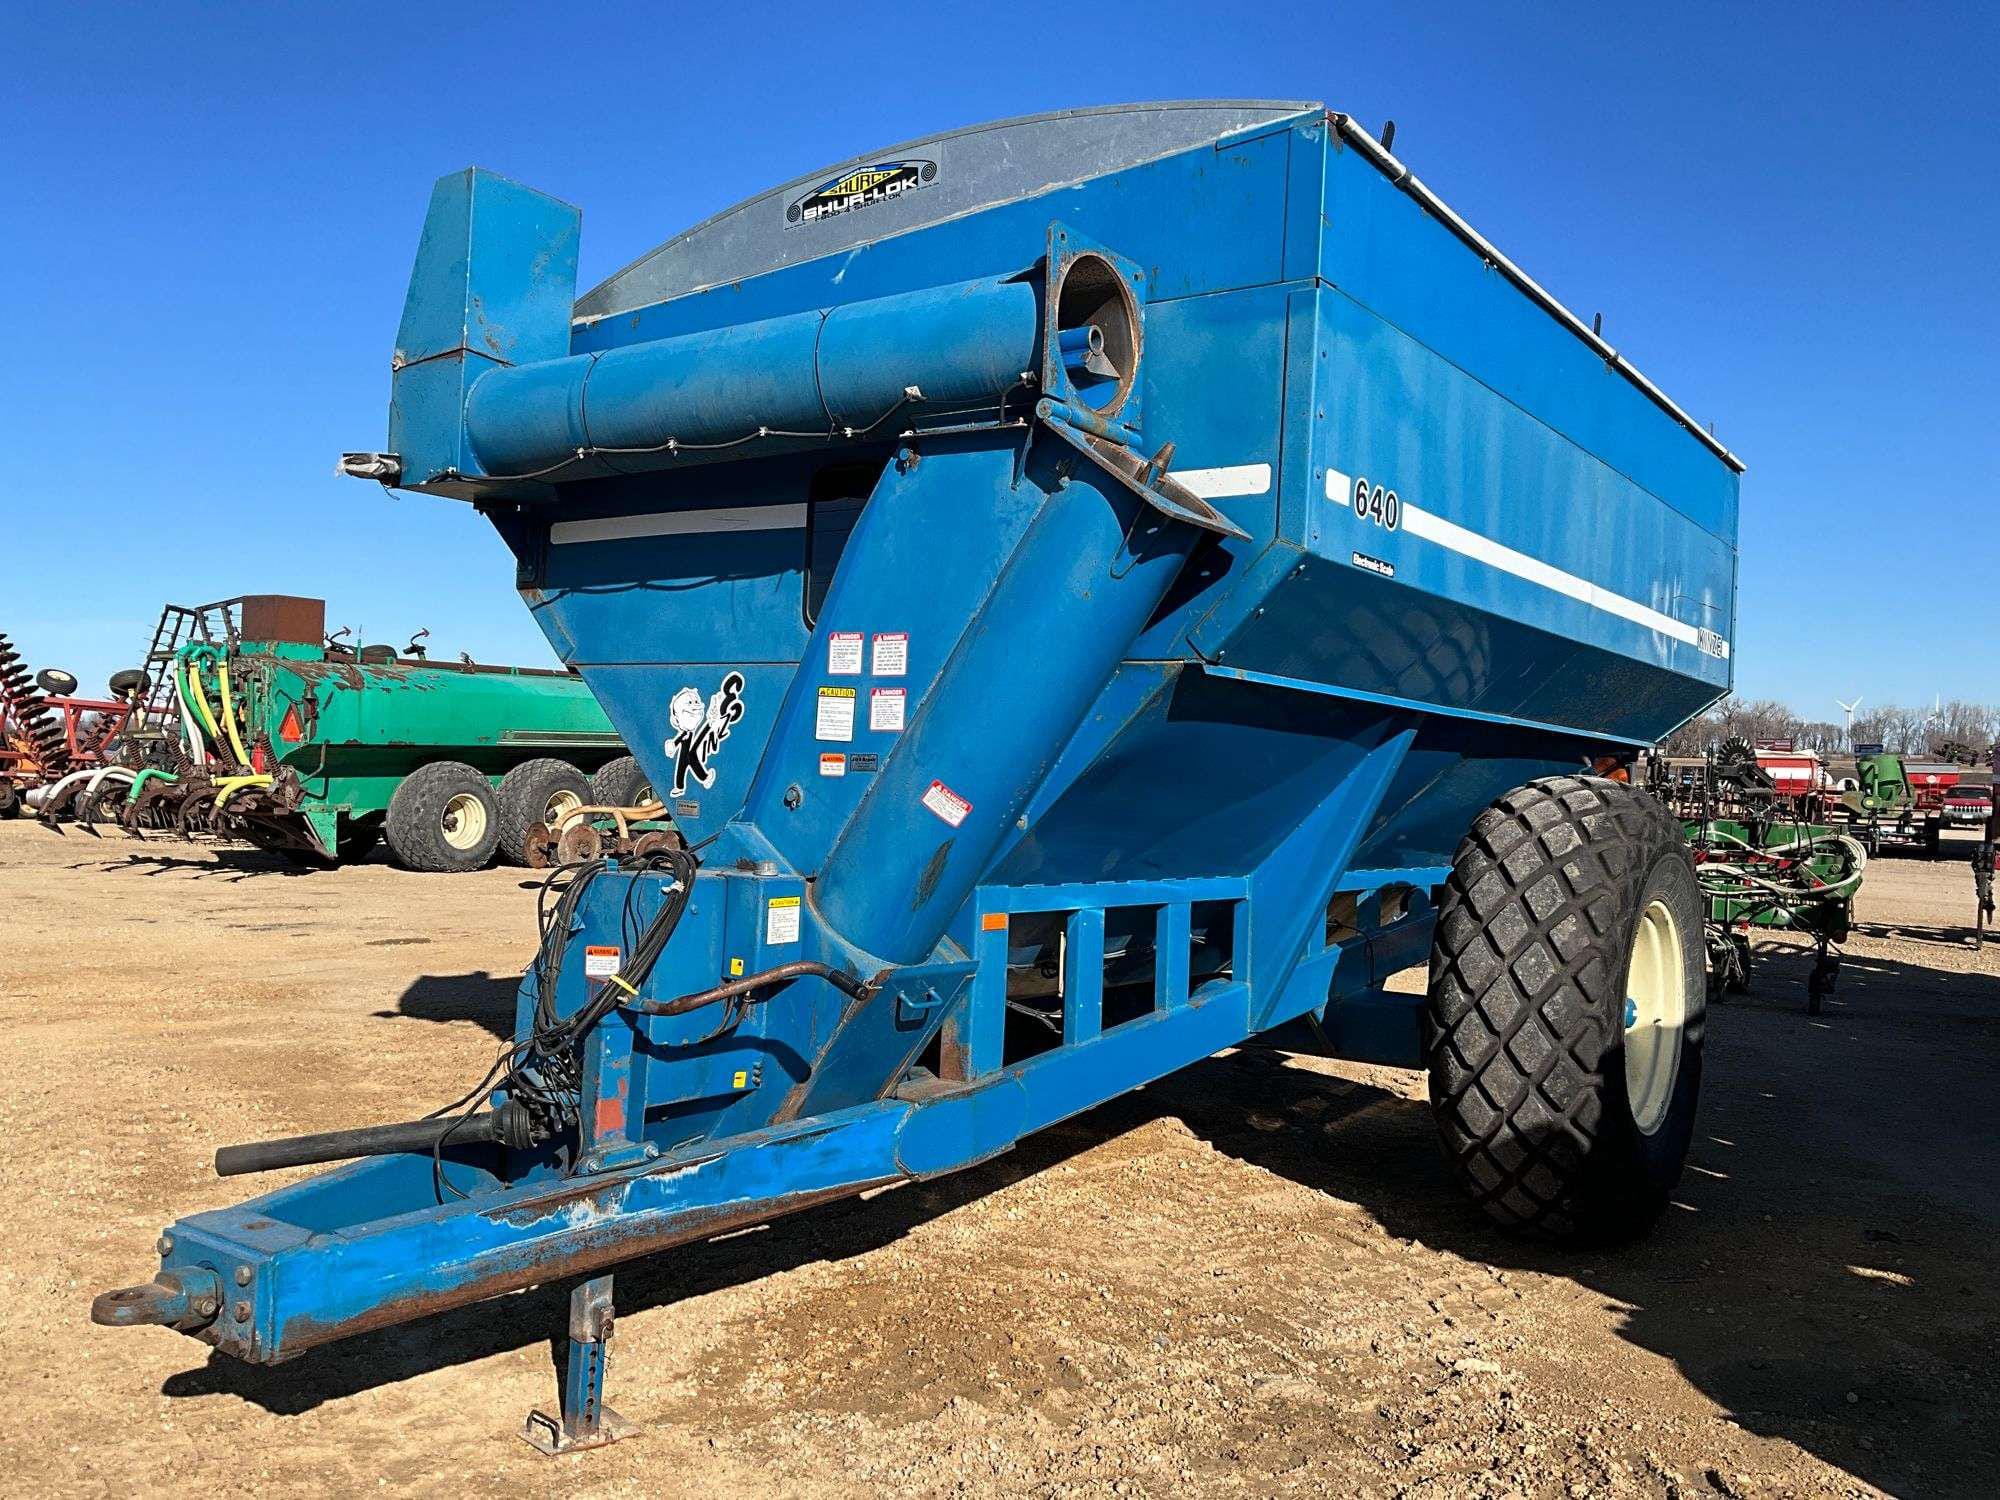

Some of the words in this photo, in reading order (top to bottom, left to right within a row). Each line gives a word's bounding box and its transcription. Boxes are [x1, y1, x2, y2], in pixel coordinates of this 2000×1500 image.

[803, 175, 918, 220] SHUR-LOK
[829, 172, 892, 195] SHURCO
[1355, 478, 1398, 531] 640
[825, 688, 854, 697] CAUTION
